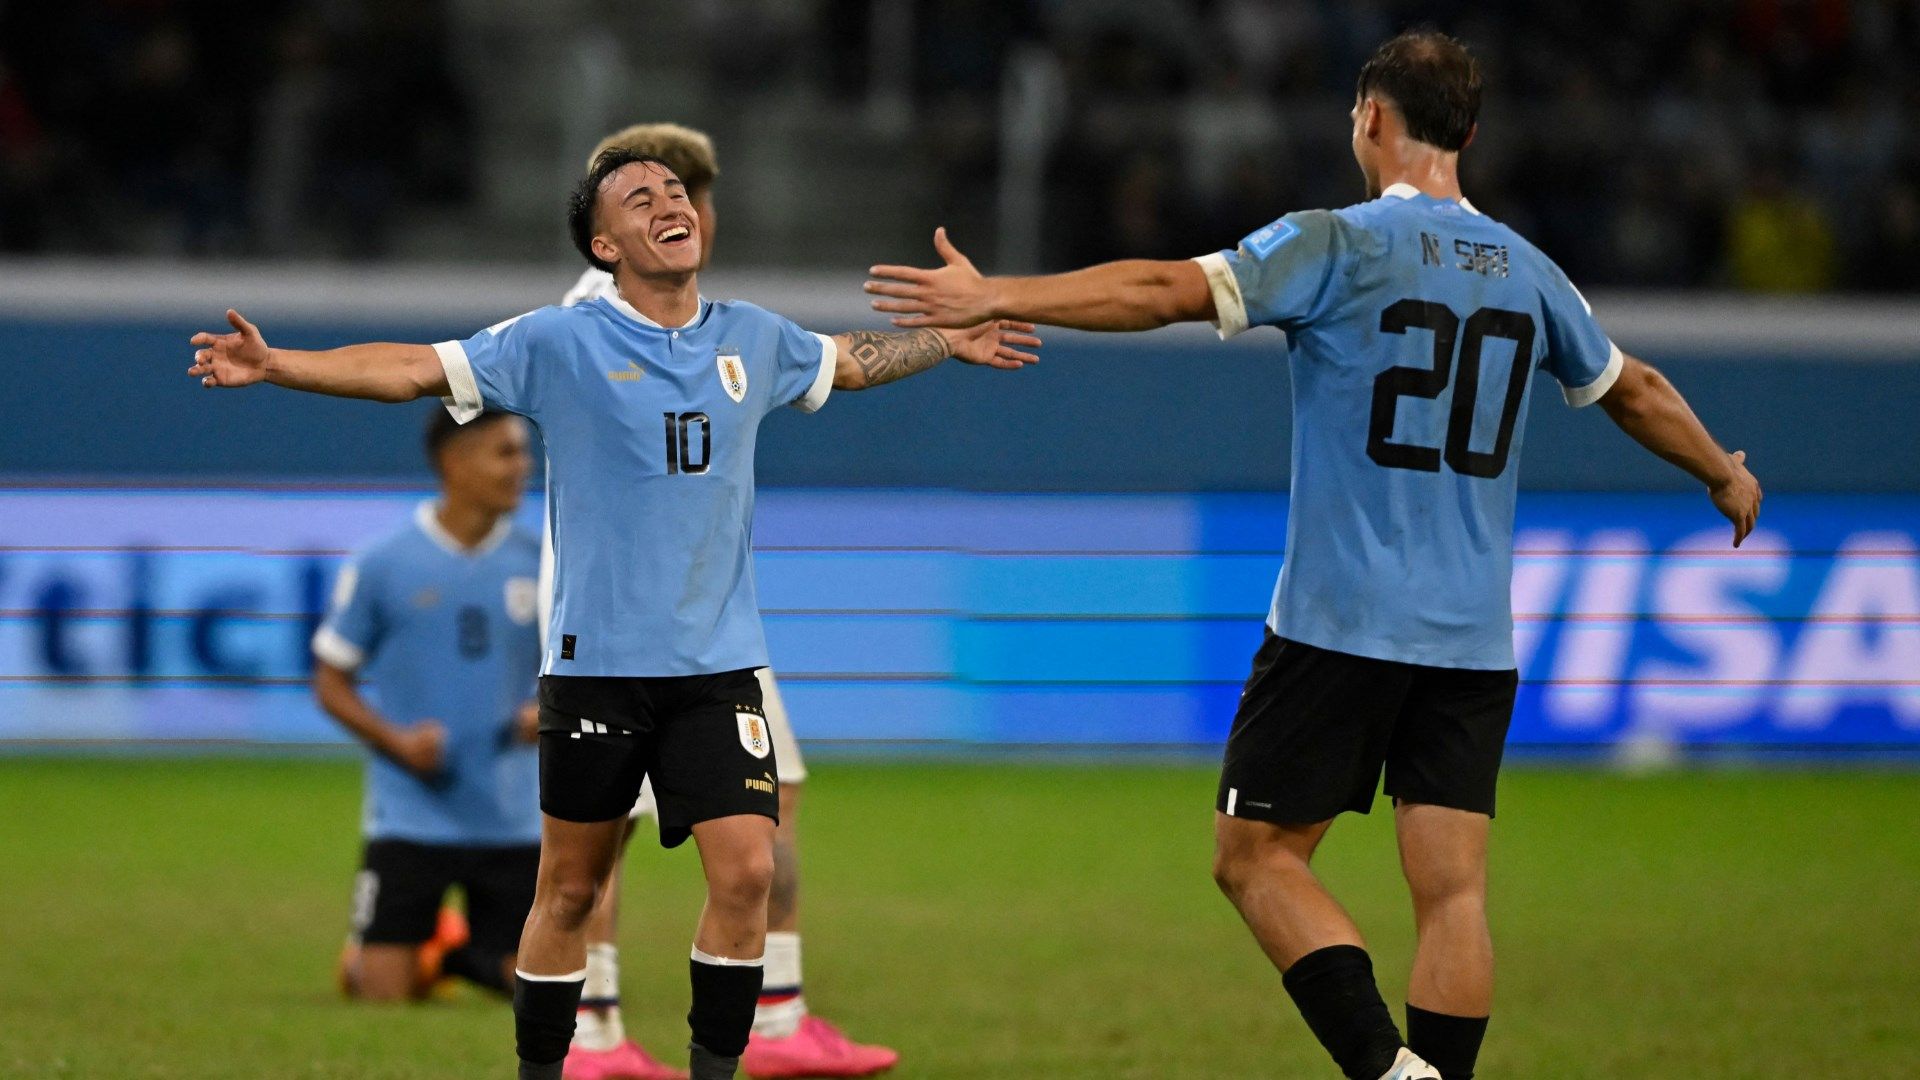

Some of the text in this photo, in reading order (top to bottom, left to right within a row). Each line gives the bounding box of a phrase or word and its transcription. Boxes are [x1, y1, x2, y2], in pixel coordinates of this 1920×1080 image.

[1454, 238, 1508, 279] SIRI
[1366, 298, 1536, 479] 20
[662, 411, 711, 476] 10
[745, 778, 773, 794] PUMA
